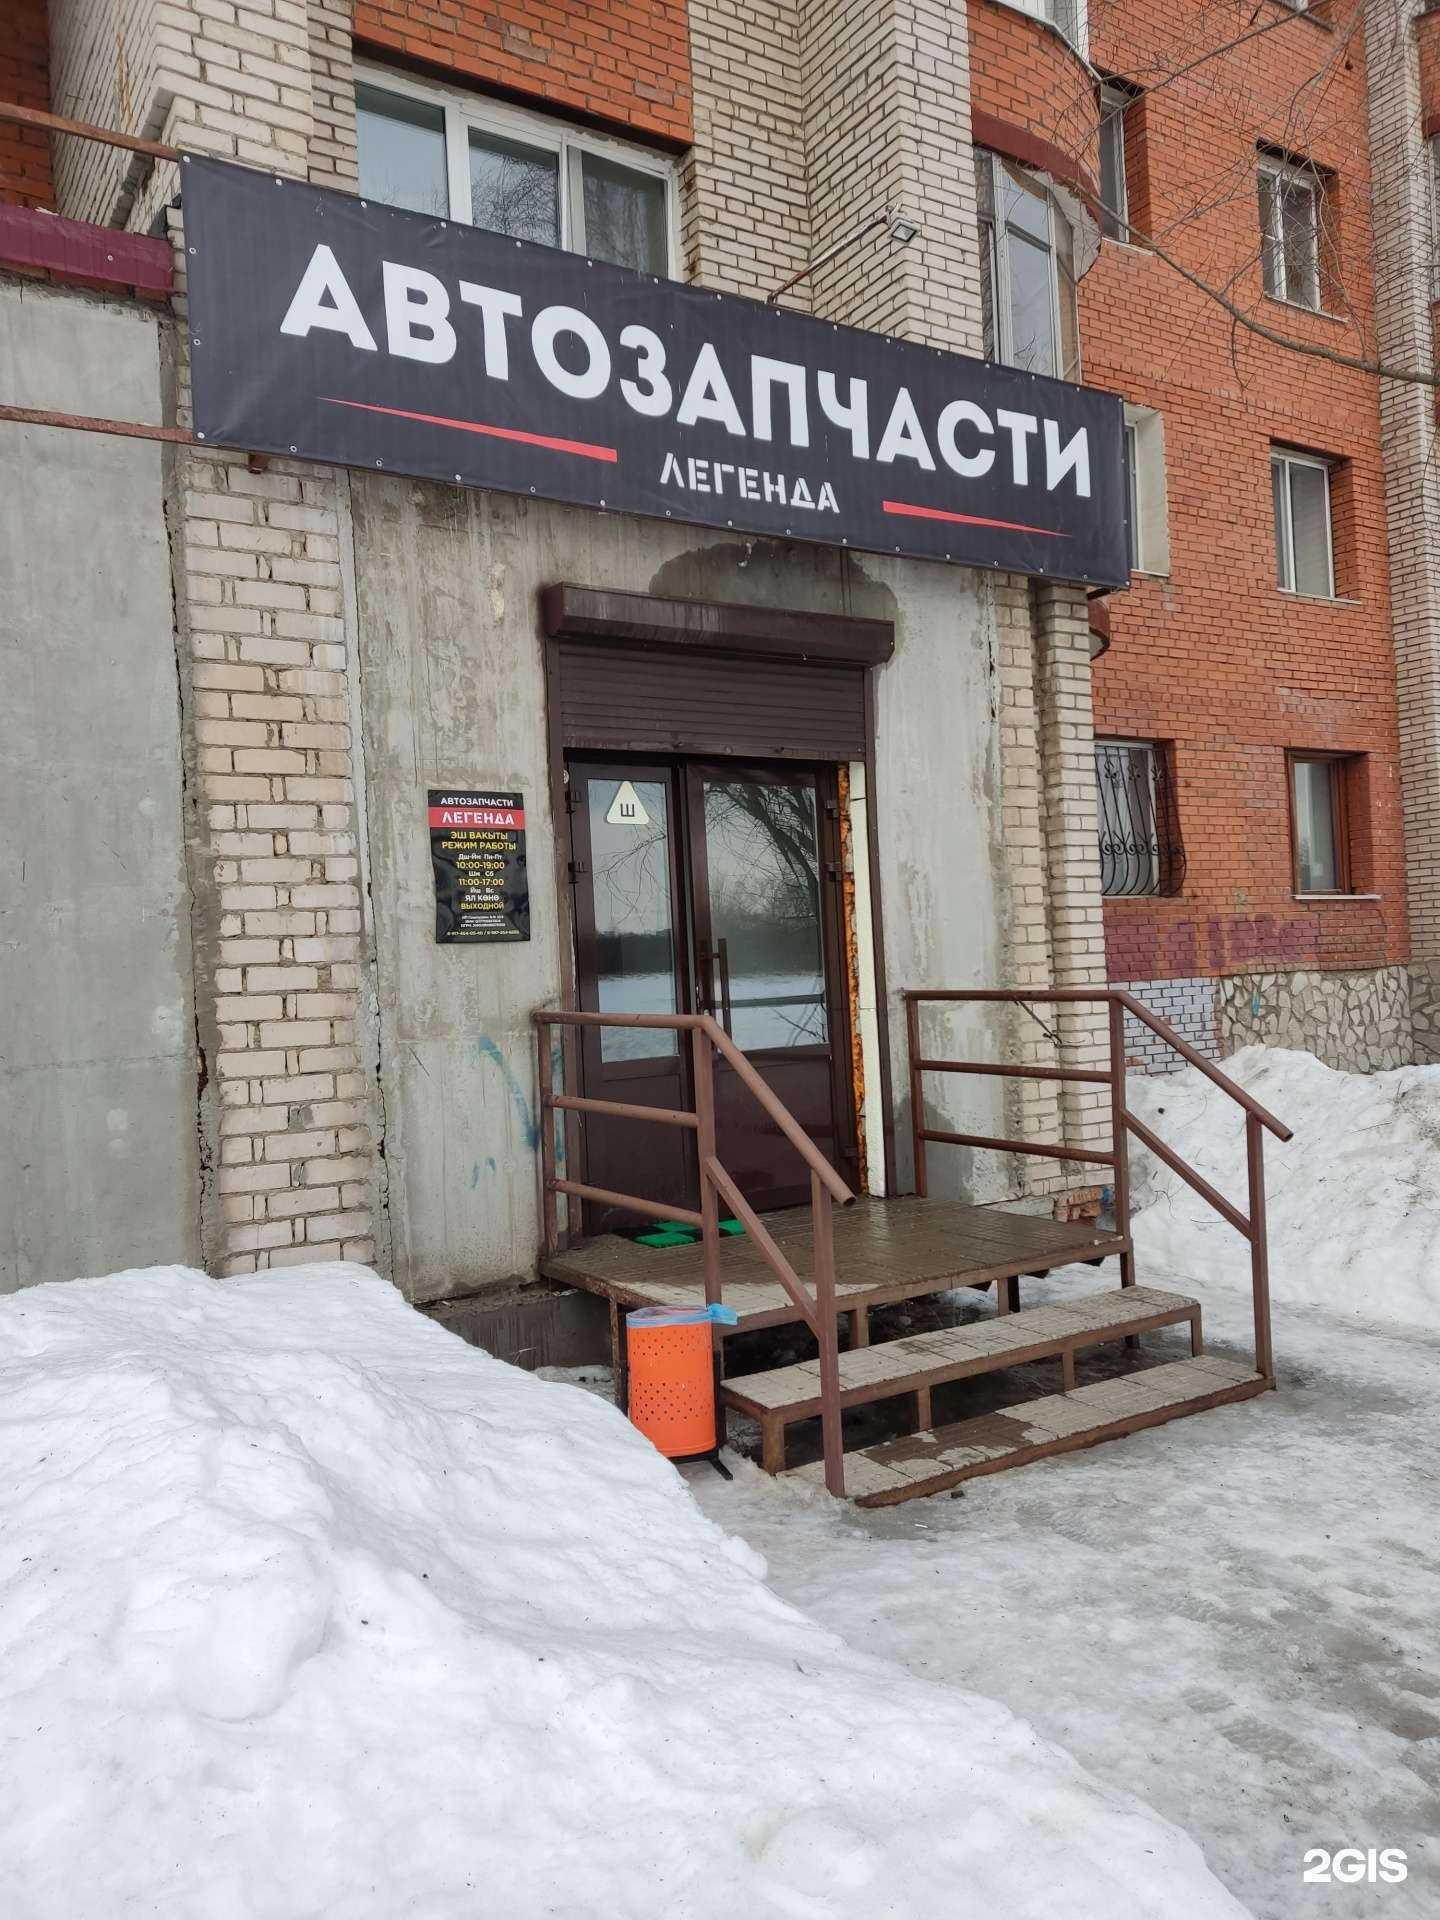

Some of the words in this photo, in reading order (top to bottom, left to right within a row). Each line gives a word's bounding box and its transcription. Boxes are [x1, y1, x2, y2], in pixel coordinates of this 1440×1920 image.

[280, 244, 1092, 498] АВТОЗАПЧАСТИ
[660, 452, 840, 514] ЛЕГЕНДА
[440, 797, 514, 807] АВТОЗАПЧАСТИ
[620, 803, 635, 817] Ш
[442, 811, 515, 825] ЛЕГЕНДА
[451, 831, 467, 840] ЭШ
[469, 832, 508, 840] ВАКЫТЫ
[441, 841, 478, 850] РЕЖИМ
[480, 842, 516, 850] РАБОТЫ
[456, 861, 505, 870] 10:00-19:00
[459, 878, 504, 886] 11:00-17:00
[465, 894, 476, 902] ЯЛ
[461, 902, 504, 910] ВЫХОДНОЙ
